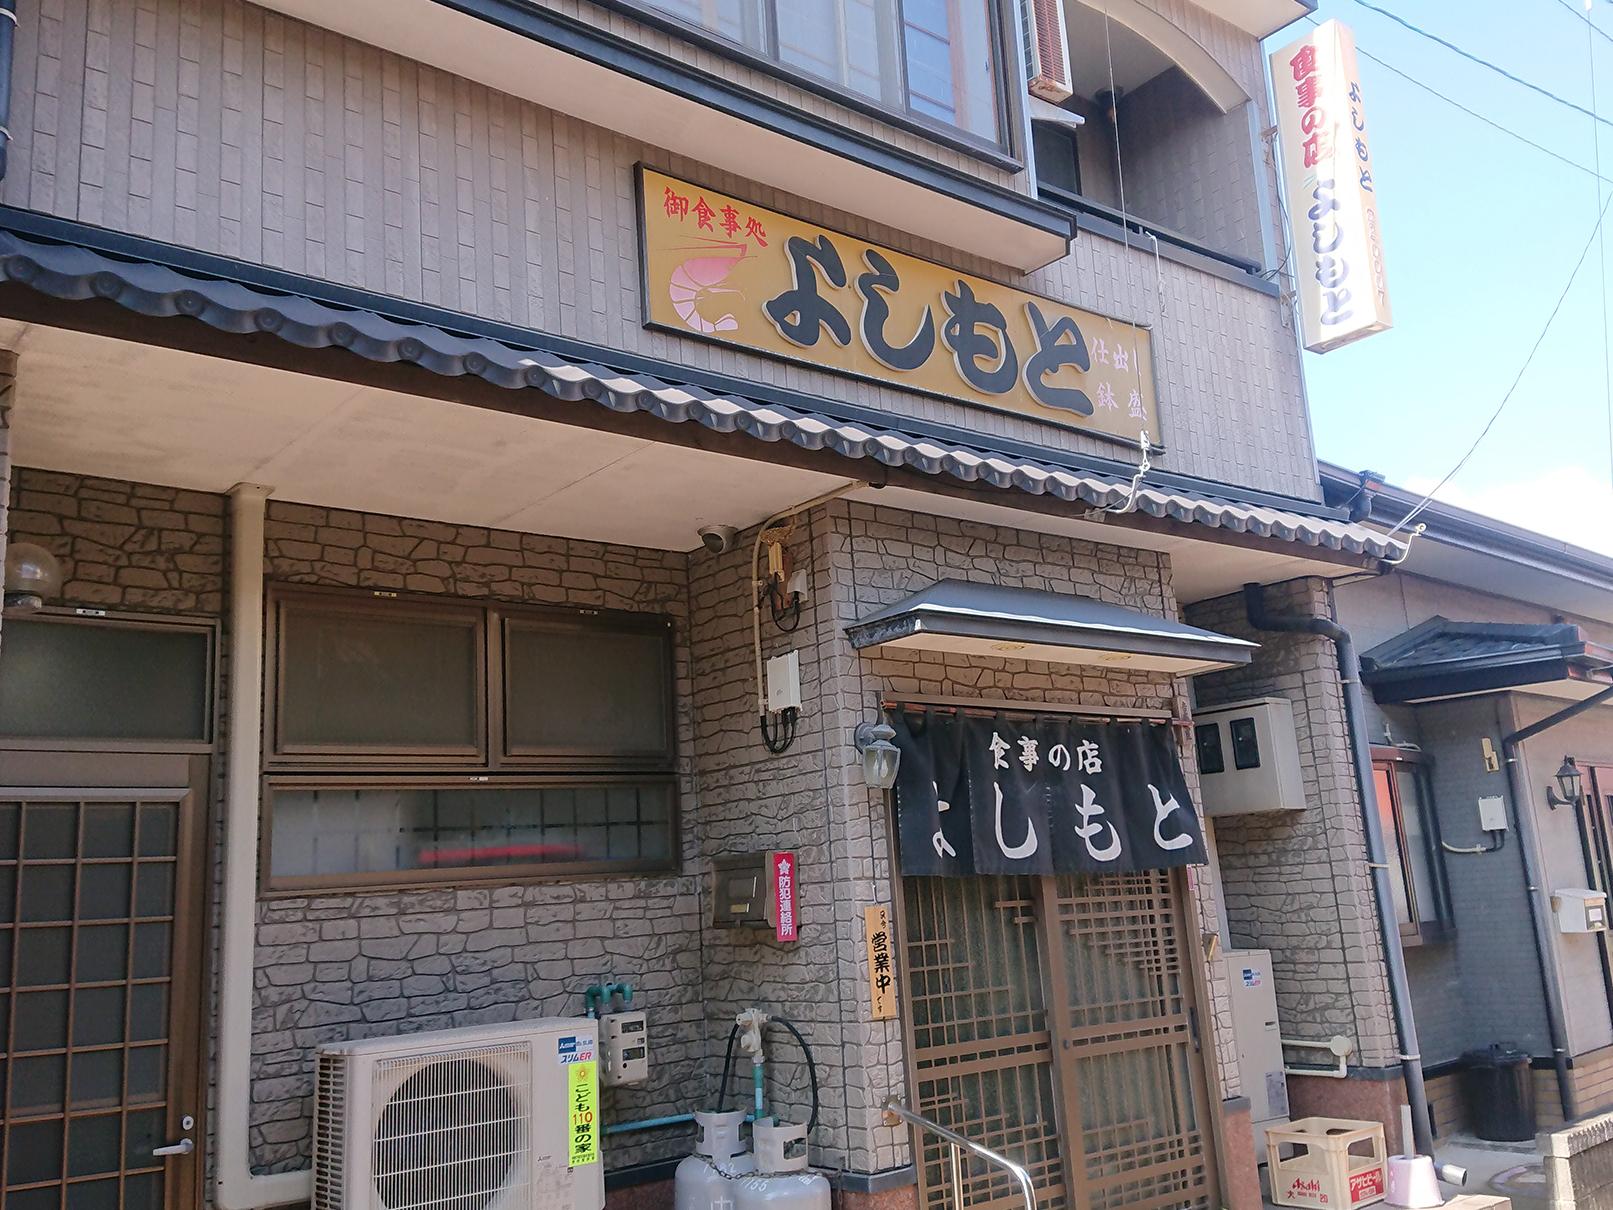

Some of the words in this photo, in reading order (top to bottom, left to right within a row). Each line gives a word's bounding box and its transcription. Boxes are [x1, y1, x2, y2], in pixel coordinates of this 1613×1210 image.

[663, 186, 769, 248] 御食事処
[762, 233, 1095, 417] よしもと
[988, 731, 1102, 775] 食事の店
[778, 876, 793, 937] 防犯連絡所
[871, 931, 892, 994] 営業中
[572, 1083, 593, 1154] こども110番の家
